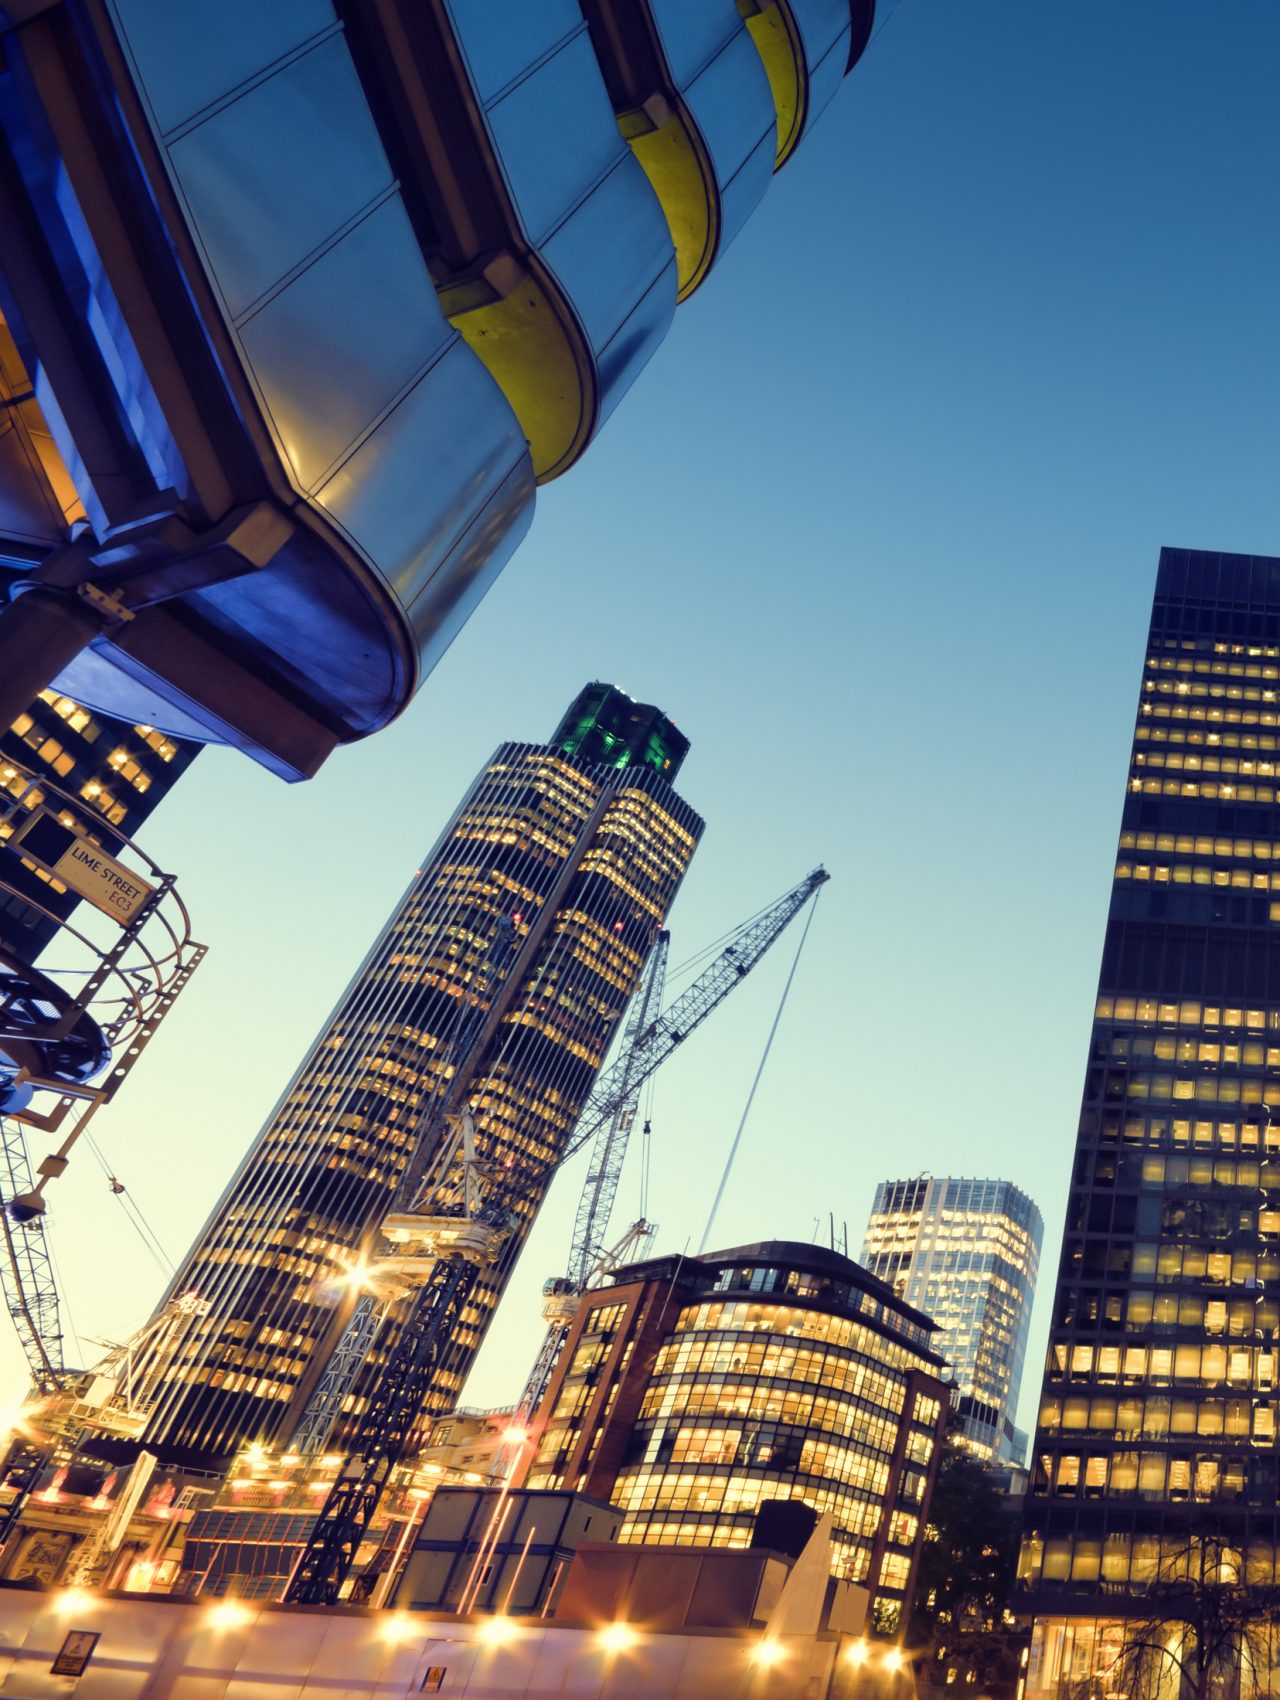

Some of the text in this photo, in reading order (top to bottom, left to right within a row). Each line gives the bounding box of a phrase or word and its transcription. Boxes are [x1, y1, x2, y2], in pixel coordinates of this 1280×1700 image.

[72, 847, 141, 899] LIME STREET
[108, 891, 133, 912] EC3
